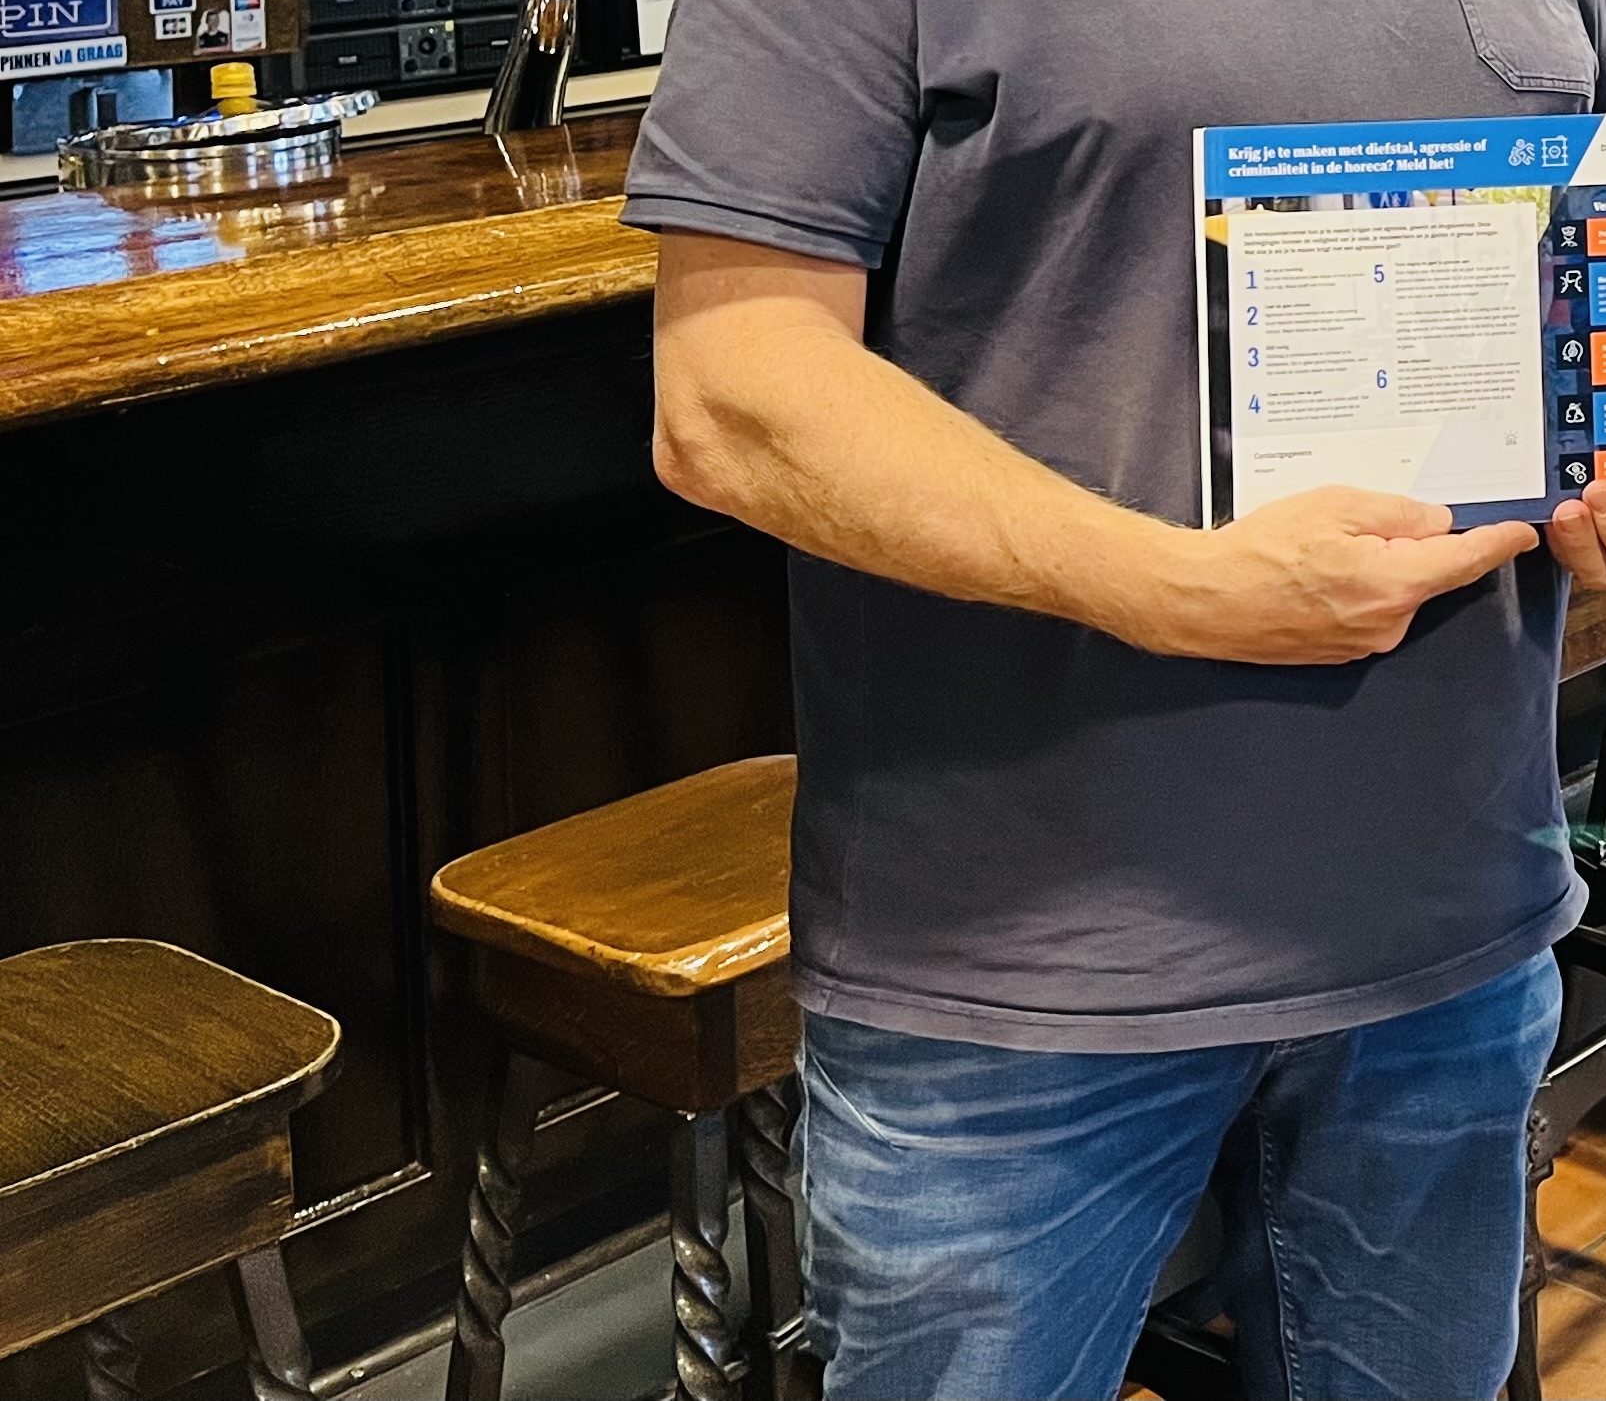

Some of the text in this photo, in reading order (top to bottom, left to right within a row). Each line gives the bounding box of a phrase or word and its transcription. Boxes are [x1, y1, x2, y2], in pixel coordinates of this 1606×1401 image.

[0, 0, 83, 31] PIN
[0, 43, 124, 72] PINNEN JA GRAAG
[1228, 139, 1487, 162] Krijg je te maken met diefstal, agressie of
[1228, 157, 1455, 177] criminaliteit in de horeca? Meld het!
[1245, 270, 1258, 290] 1
[1373, 263, 1385, 283] 5
[1246, 306, 1258, 326] 2
[1247, 347, 1259, 367] 3
[1248, 394, 1261, 414] 4
[1376, 369, 1388, 388] 6
